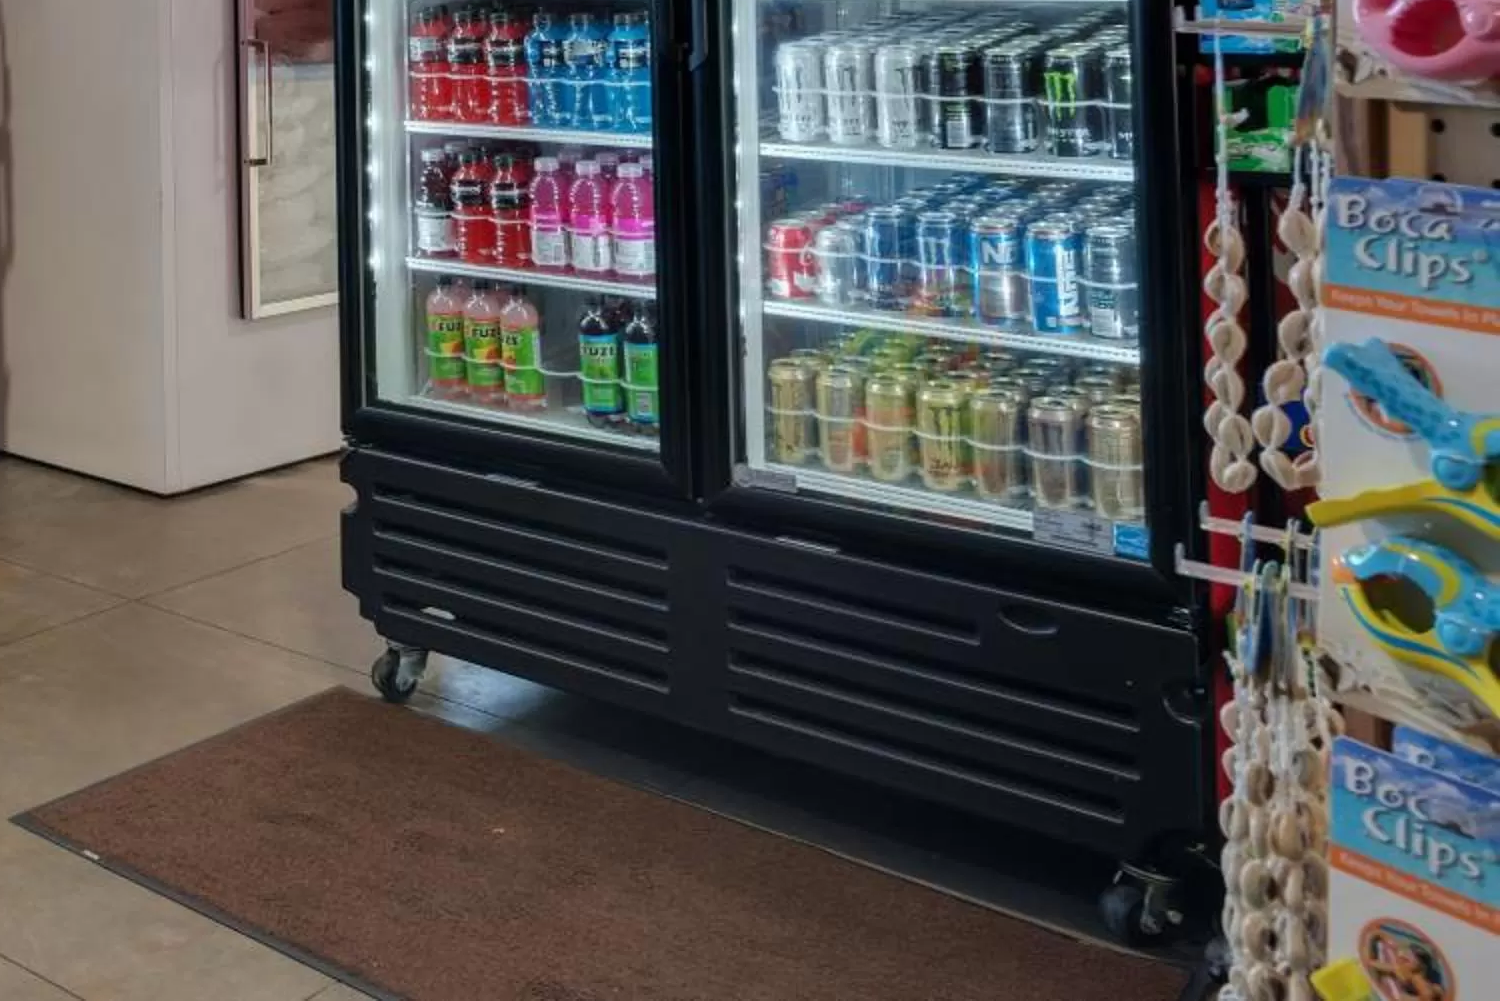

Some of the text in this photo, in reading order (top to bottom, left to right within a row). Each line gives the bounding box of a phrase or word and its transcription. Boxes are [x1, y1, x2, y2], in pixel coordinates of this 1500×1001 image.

[1337, 193, 1453, 240] Boca
[1355, 235, 1474, 290] Clips
[1345, 757, 1429, 821] Boc
[1362, 807, 1483, 880] Clips
